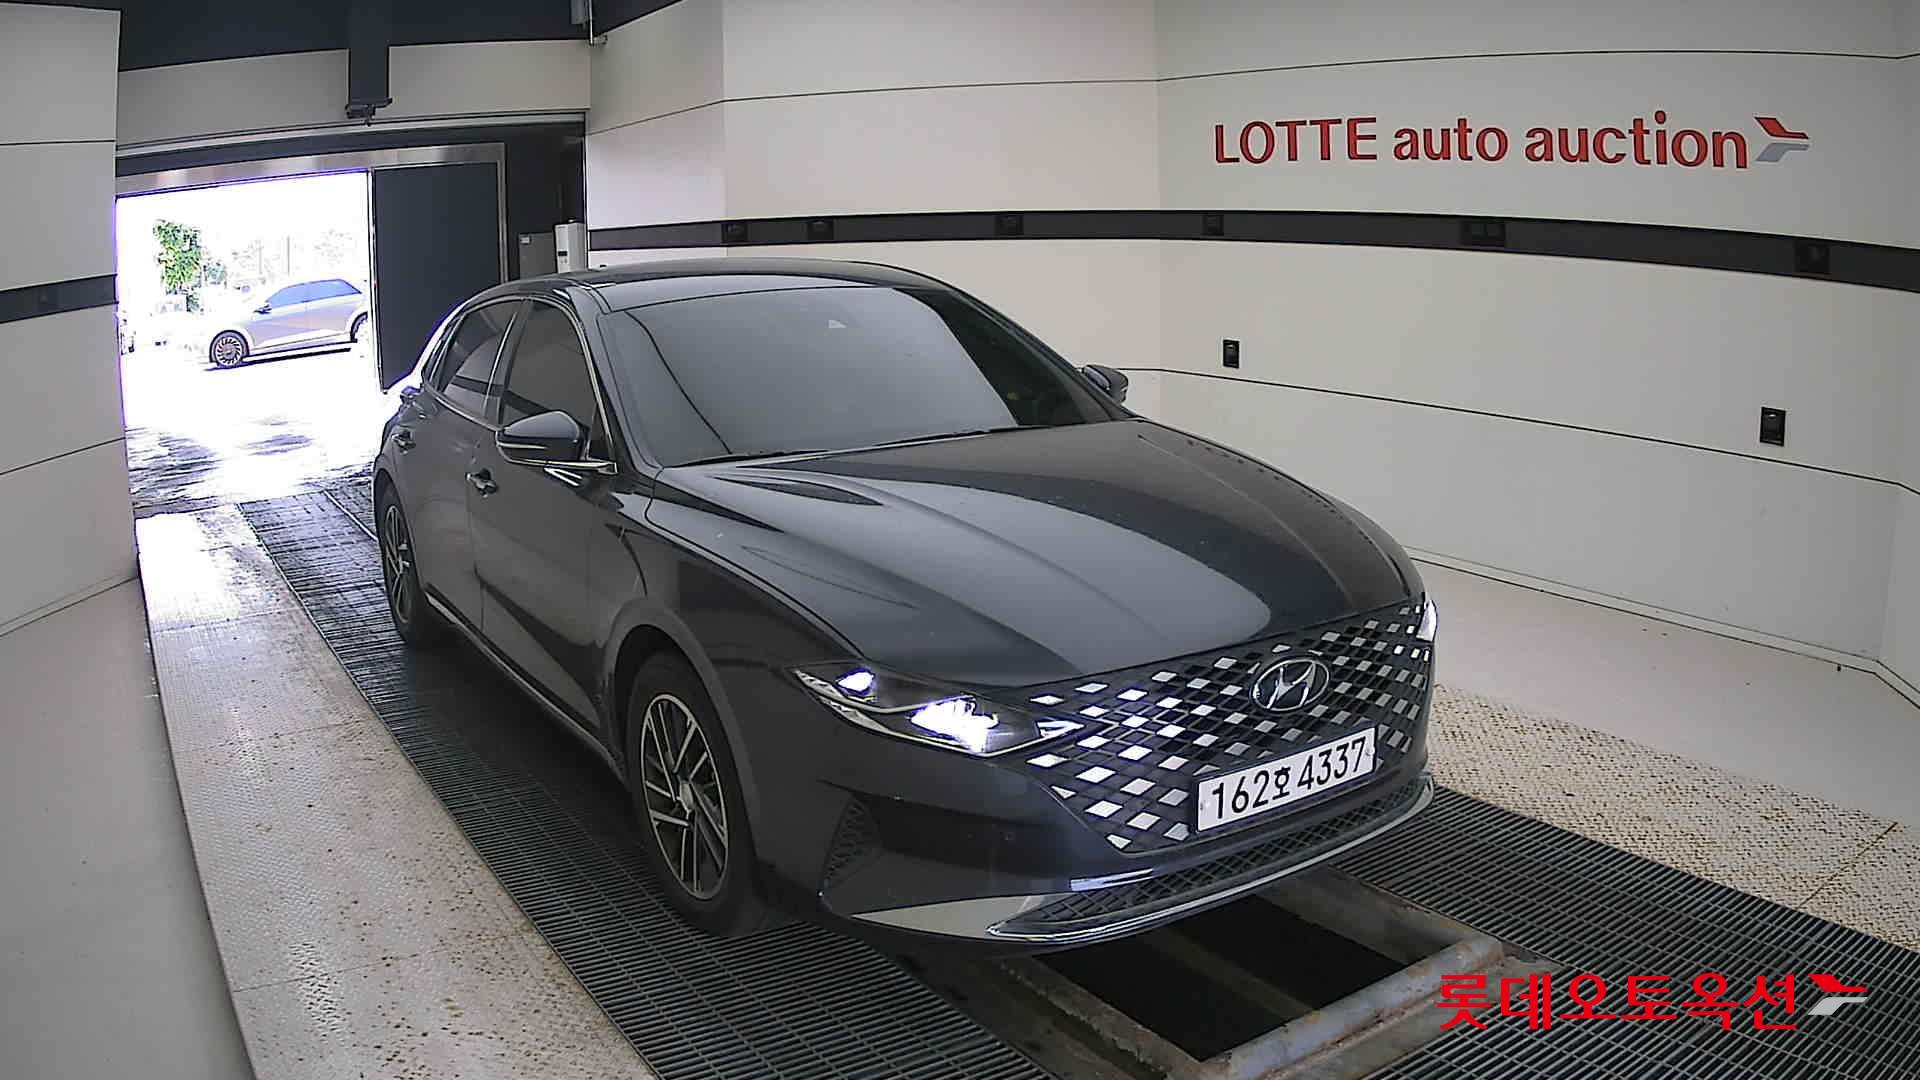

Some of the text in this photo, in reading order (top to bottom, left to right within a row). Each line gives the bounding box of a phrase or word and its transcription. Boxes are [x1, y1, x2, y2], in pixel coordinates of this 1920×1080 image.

[1214, 111, 1748, 168] LOTTE auto auction
[1297, 736, 1366, 790] 4337
